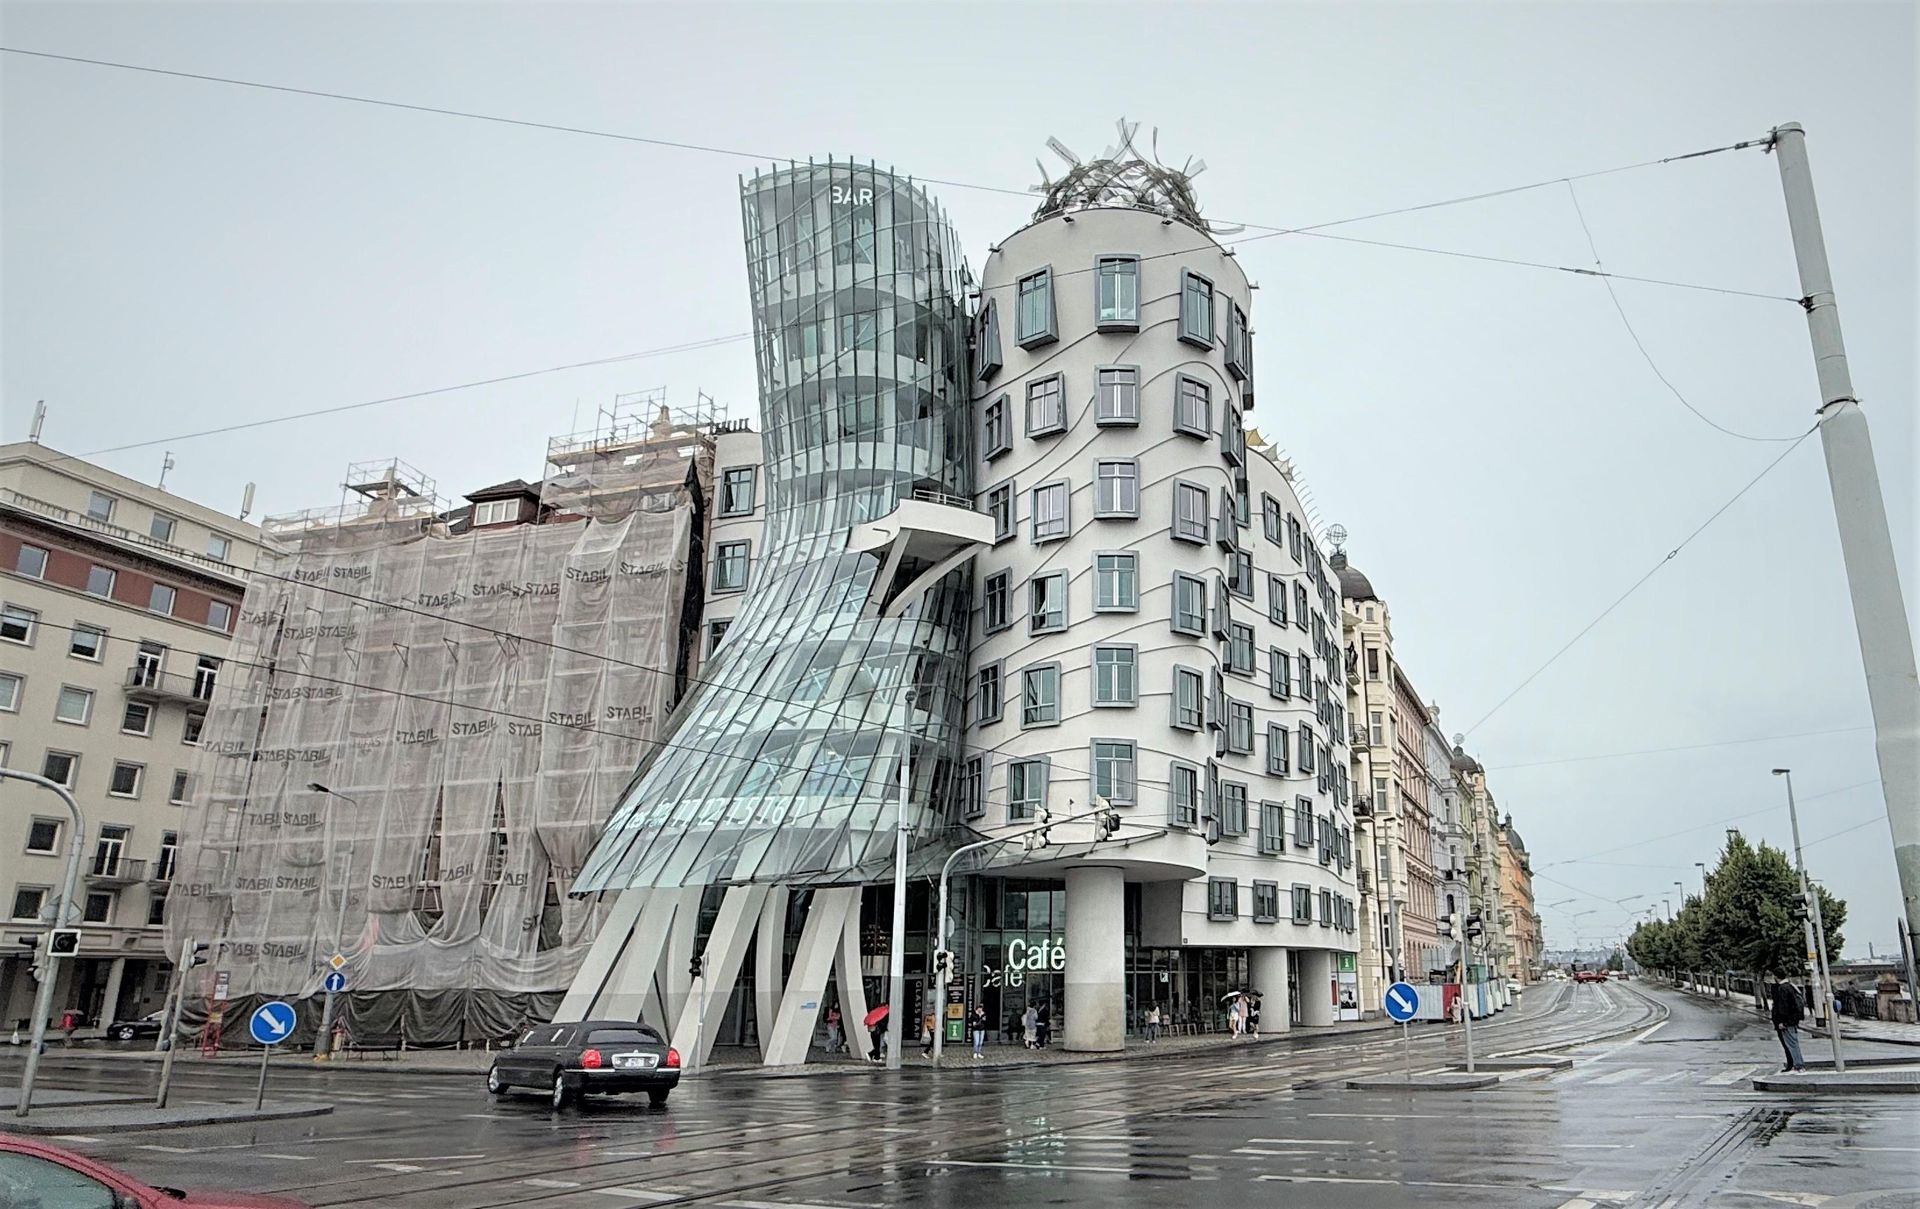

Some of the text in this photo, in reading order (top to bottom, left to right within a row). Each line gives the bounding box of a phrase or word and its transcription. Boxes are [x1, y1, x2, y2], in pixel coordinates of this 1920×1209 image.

[829, 185, 874, 206] BAR
[333, 565, 371, 580] STABIL
[566, 567, 609, 583] STABIL
[526, 582, 559, 596] STAB
[452, 716, 498, 735] STABIL
[550, 712, 597, 727] STABIL
[508, 722, 542, 736] STAB
[287, 748, 330, 762] STABIL
[283, 811, 321, 826] STABIL
[276, 876, 318, 890] STABIL
[263, 942, 306, 958] STABIL
[1008, 937, 1066, 970] Café
[915, 980, 923, 1014] GLASS
